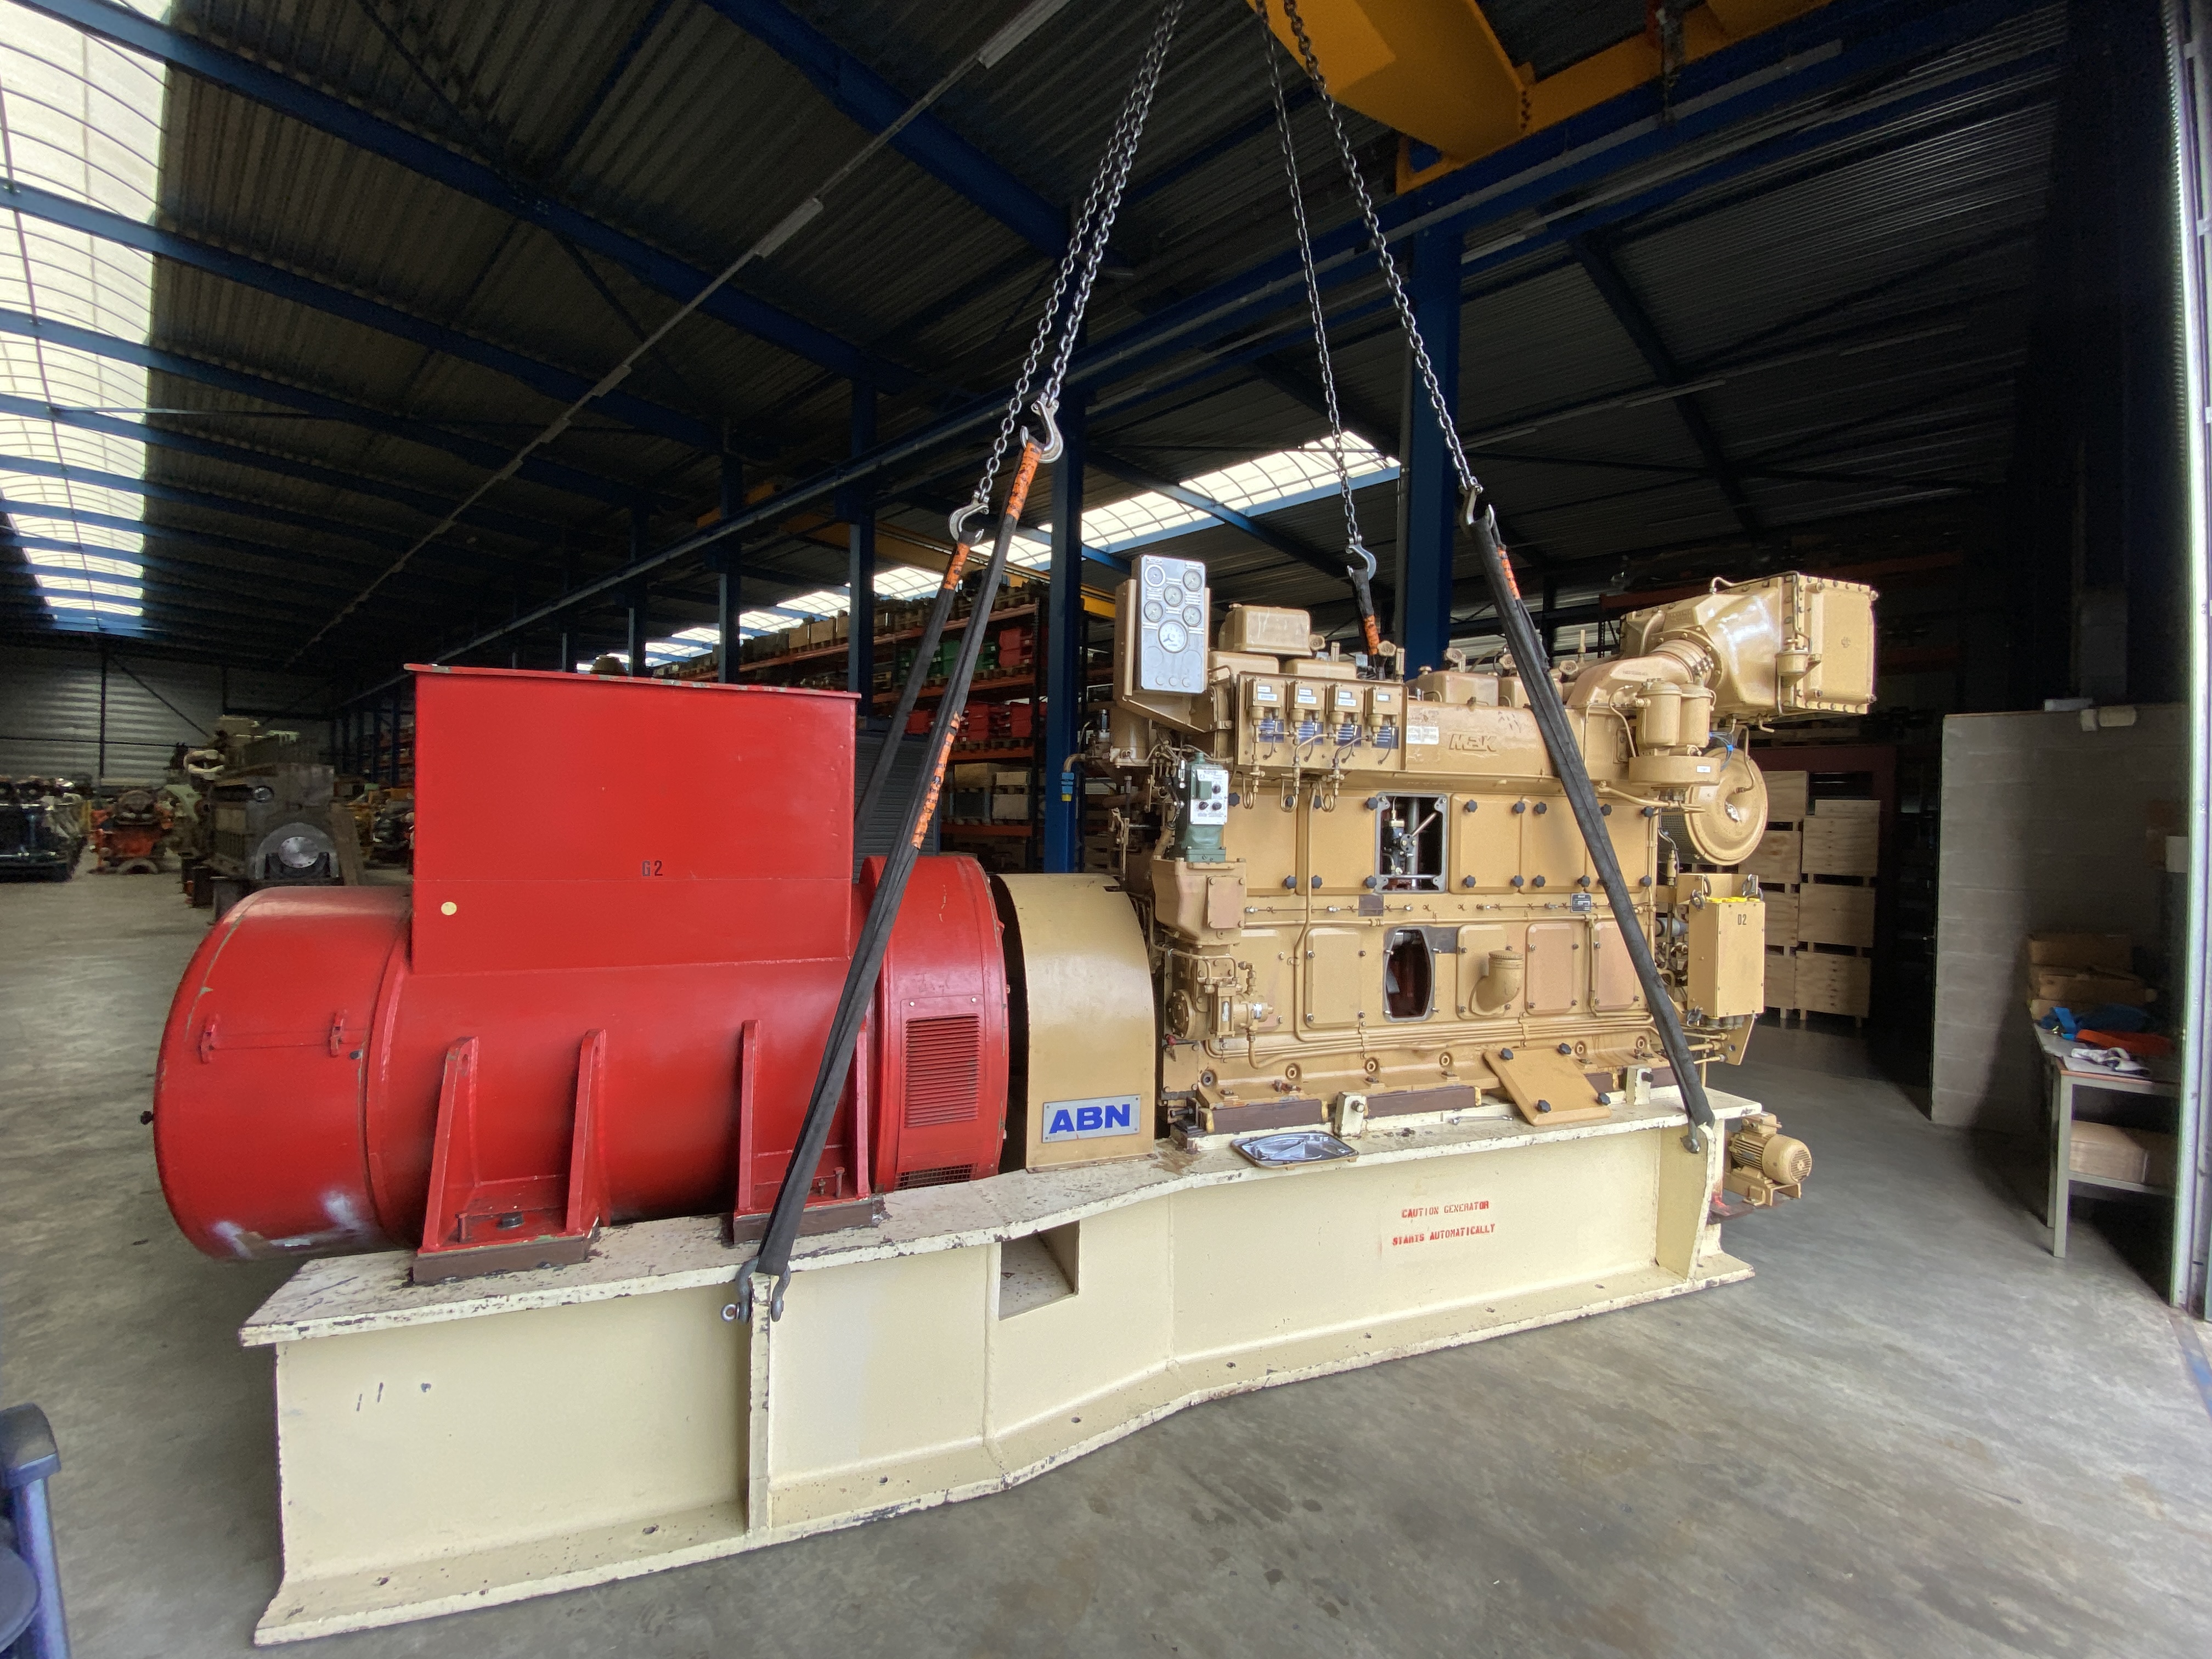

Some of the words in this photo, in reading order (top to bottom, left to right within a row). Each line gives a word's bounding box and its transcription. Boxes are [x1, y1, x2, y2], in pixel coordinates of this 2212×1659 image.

[642, 860, 663, 877] G2
[1049, 1104, 1130, 1134] ABN
[1401, 1206, 1439, 1218] CAUTION
[1444, 1200, 1489, 1214] GENERATOR
[1392, 1233, 1425, 1246] STARTS
[1429, 1223, 1496, 1241] AUTOMATICALLY
